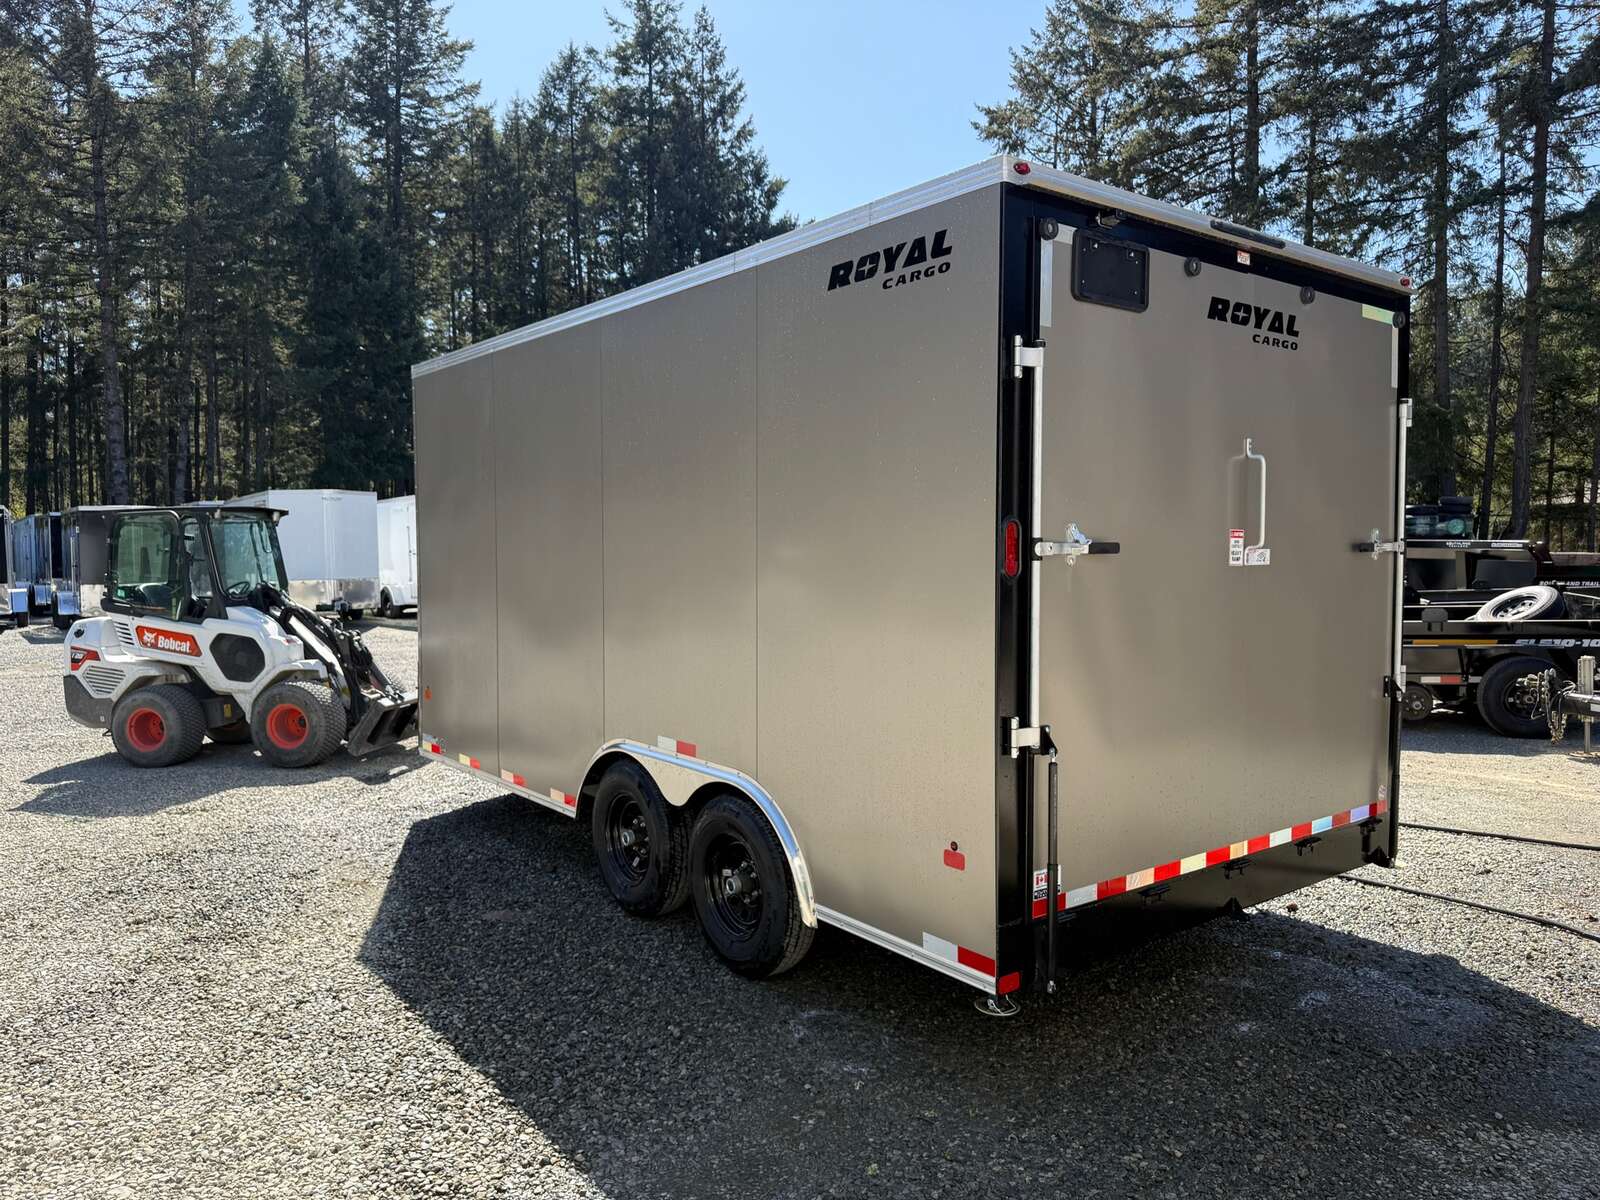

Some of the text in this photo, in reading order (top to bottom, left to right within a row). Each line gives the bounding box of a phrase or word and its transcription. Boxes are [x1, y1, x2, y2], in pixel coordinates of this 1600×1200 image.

[827, 229, 953, 291] ROYAL
[882, 262, 951, 290] CARGO
[1207, 296, 1299, 337] ROYAL
[1252, 334, 1298, 351] CARGO
[157, 635, 191, 653] Bobcat
